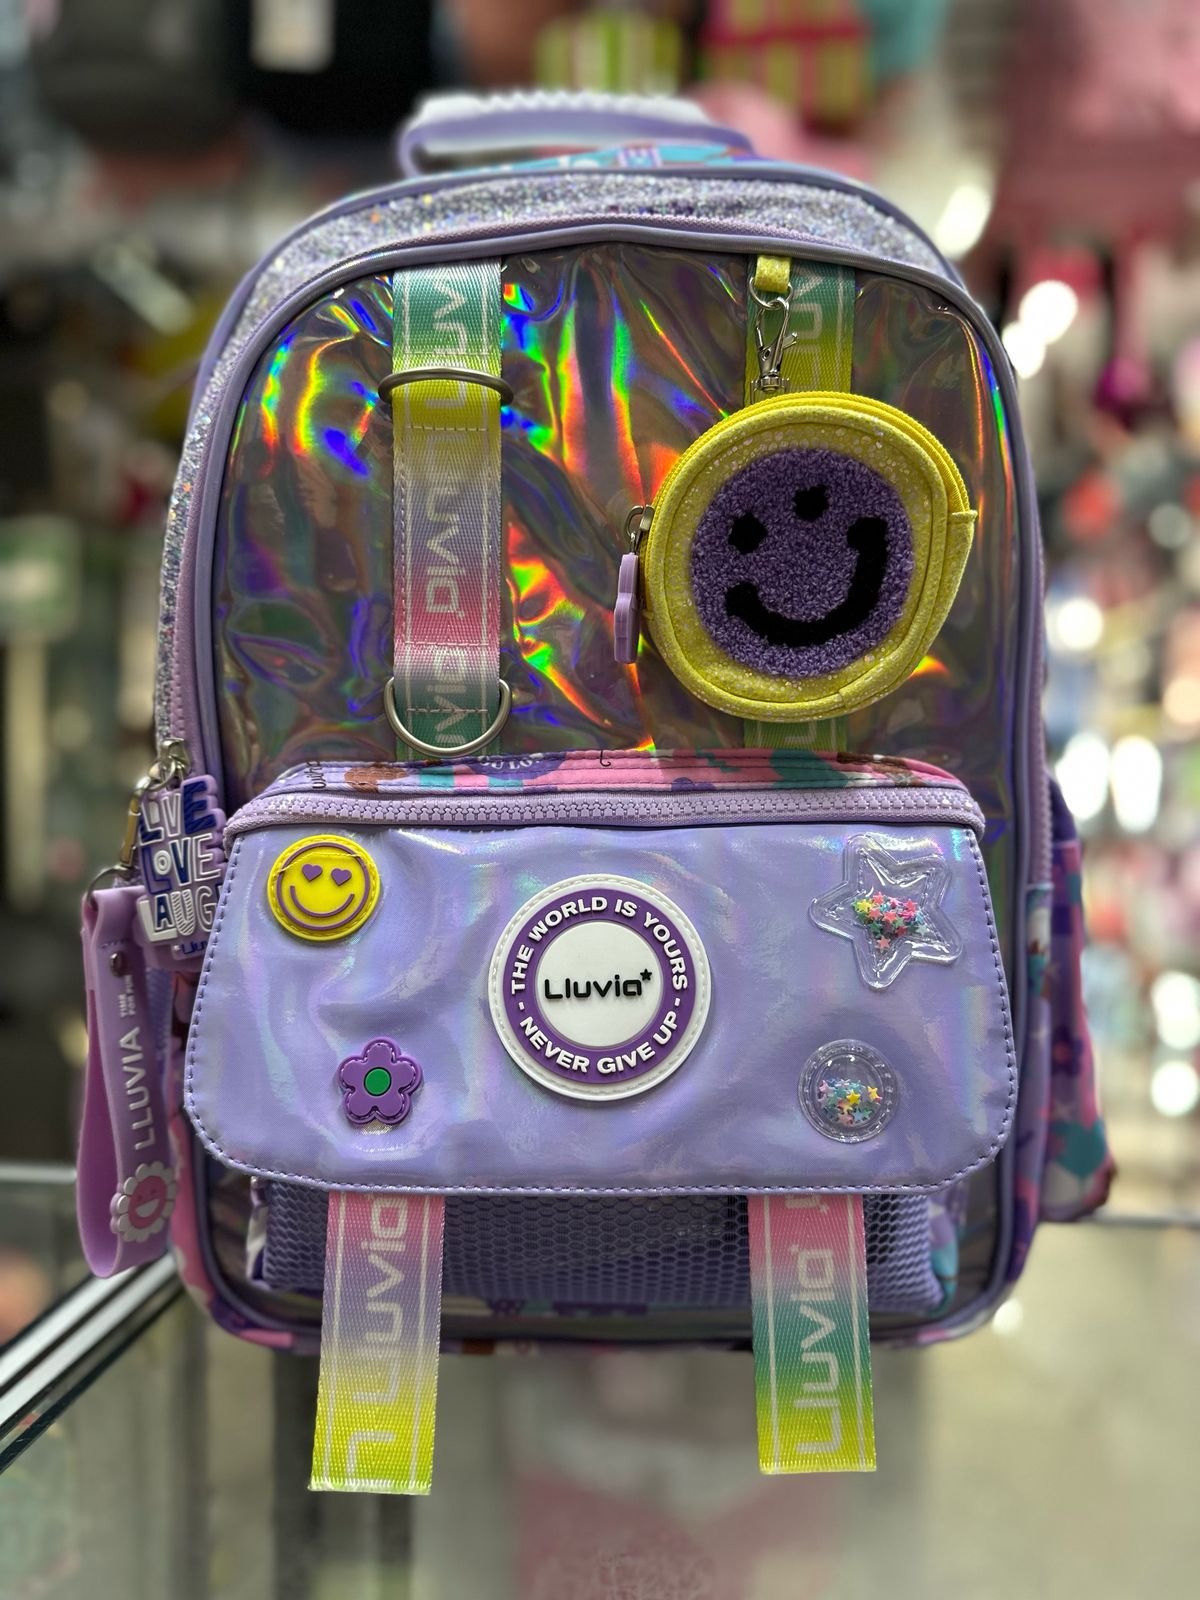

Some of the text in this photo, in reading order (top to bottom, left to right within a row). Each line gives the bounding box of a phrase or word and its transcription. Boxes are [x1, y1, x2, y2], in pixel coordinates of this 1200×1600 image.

[140, 833, 222, 895] LOVE
[138, 883, 223, 942] LAUG
[511, 896, 688, 995] THE WORLD IS YOURS
[544, 974, 643, 1000] Lluvia
[519, 1010, 678, 1075] NEVER GIVE UP
[119, 1026, 156, 1151] LLUVIA
